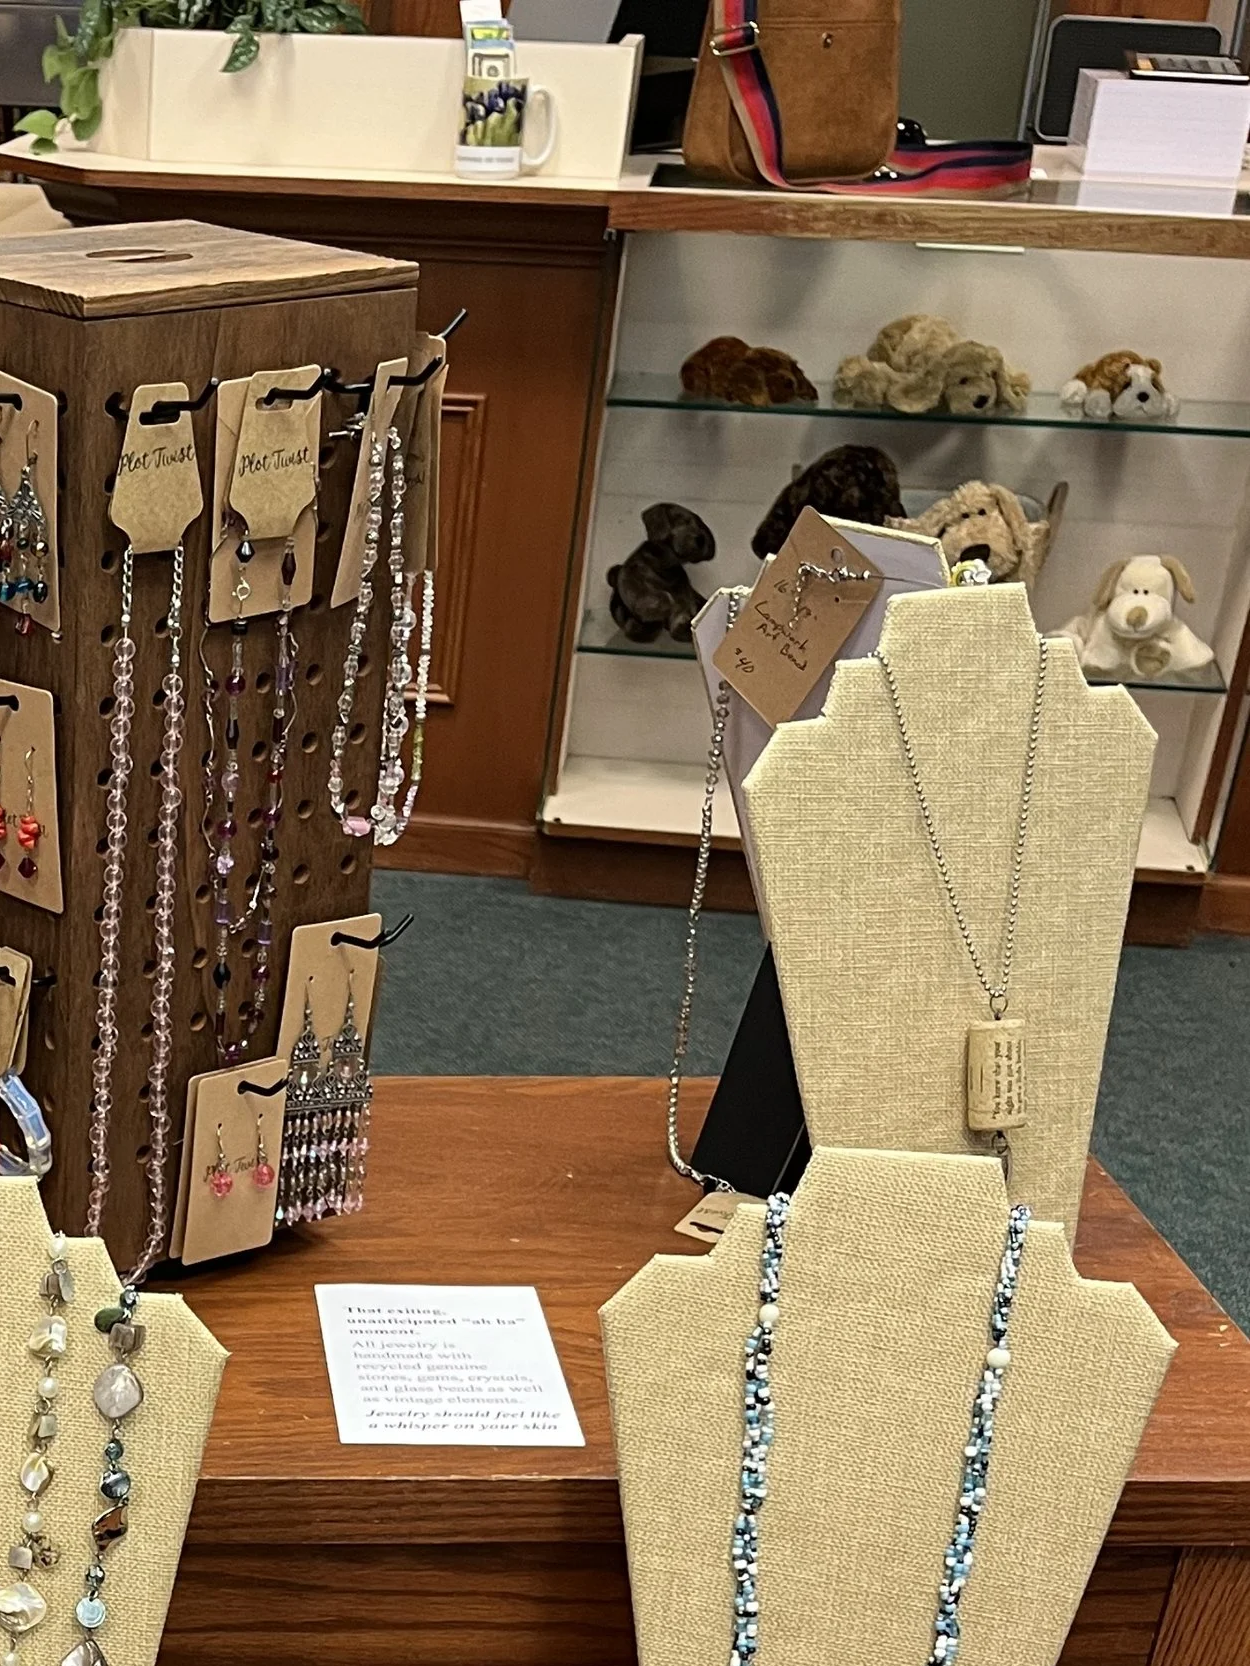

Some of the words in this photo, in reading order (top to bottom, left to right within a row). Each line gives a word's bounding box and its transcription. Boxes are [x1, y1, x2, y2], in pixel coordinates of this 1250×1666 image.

[117, 452, 151, 476] Plot
[152, 444, 195, 469] Twist
[239, 454, 271, 478] Plot
[271, 446, 310, 470] Twist
[352, 1341, 376, 1349] All
[380, 1340, 438, 1351] jewelry
[353, 1351, 434, 1360] handmade
[437, 1351, 473, 1360] with
[356, 1362, 422, 1371] recycled
[426, 1363, 489, 1372] genuine
[360, 1384, 389, 1392] and
[393, 1384, 434, 1393] glass
[437, 1384, 484, 1392] beads
[508, 1384, 544, 1393] well
[384, 1395, 444, 1405] vintage
[365, 1409, 431, 1419] Jewelry
[433, 1410, 491, 1418] should
[493, 1410, 526, 1420] feel
[530, 1410, 562, 1419] like
[383, 1421, 450, 1432] whisper
[452, 1423, 475, 1431] on
[477, 1423, 519, 1432] your
[522, 1422, 559, 1431] skin
